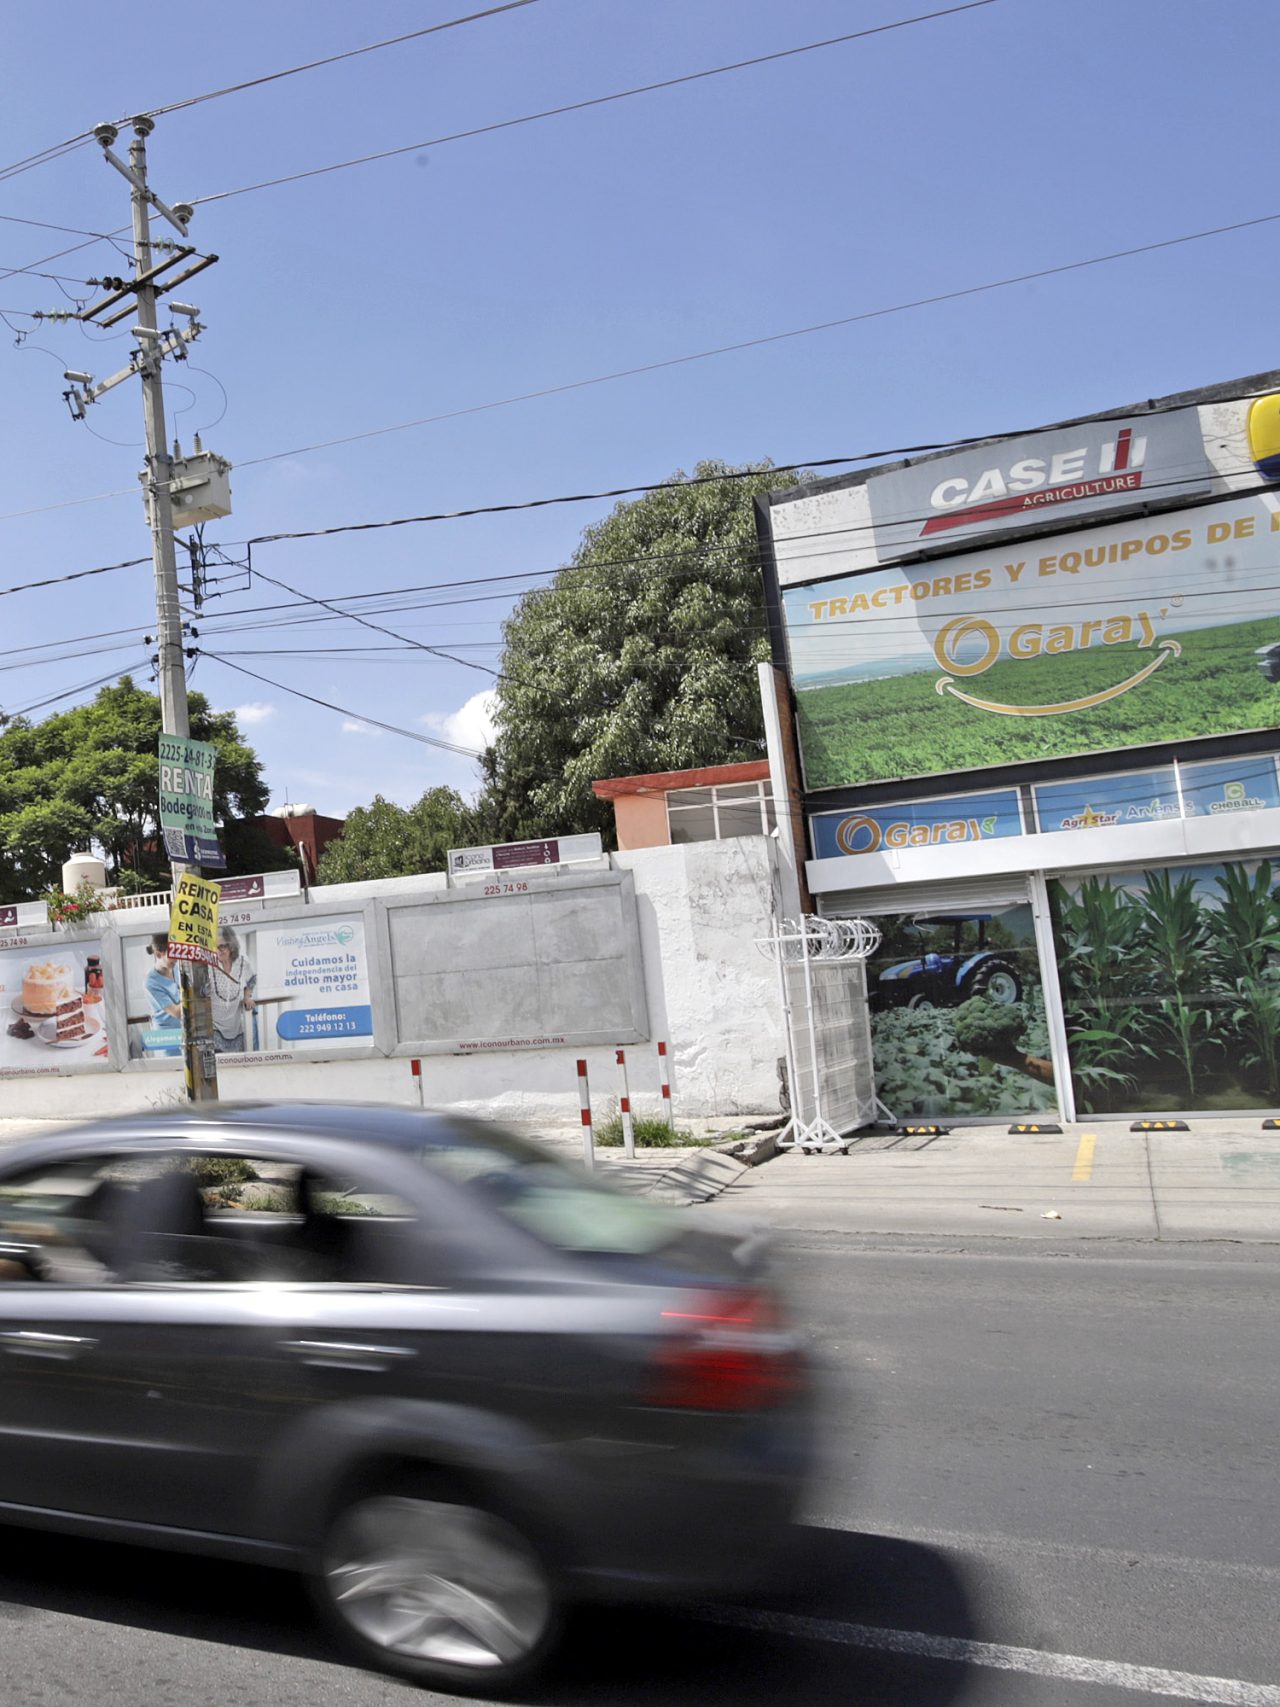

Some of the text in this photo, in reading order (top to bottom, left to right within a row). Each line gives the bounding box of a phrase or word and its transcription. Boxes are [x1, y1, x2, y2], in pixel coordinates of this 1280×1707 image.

[930, 447, 1088, 510] CASE
[1022, 475, 1136, 509] AGRICULTURE
[808, 568, 992, 620] TRACTORES
[1006, 562, 1026, 583] Y
[1037, 529, 1192, 577] EQUIPOS
[1206, 516, 1256, 545] DE
[161, 765, 213, 800] RENTA
[1126, 801, 1193, 818] Arvenss
[1091, 813, 1117, 825] Star
[178, 881, 218, 905] RENTO
[484, 883, 528, 895] 225 74 98
[178, 900, 214, 924] CASA
[218, 913, 251, 925] 25 74 98
[178, 922, 213, 939] EN ESTA
[10, 938, 18, 947] 74
[185, 933, 209, 948] ZONA
[291, 953, 356, 968] Cuidamos la
[285, 963, 357, 977] independencia del
[284, 973, 358, 987] adulto mayor
[319, 983, 358, 993] en casa
[304, 1012, 346, 1022] Teléfono:
[299, 1021, 357, 1033] 222 949 12 13
[459, 1037, 565, 1049] www.iconourbano.com.mx
